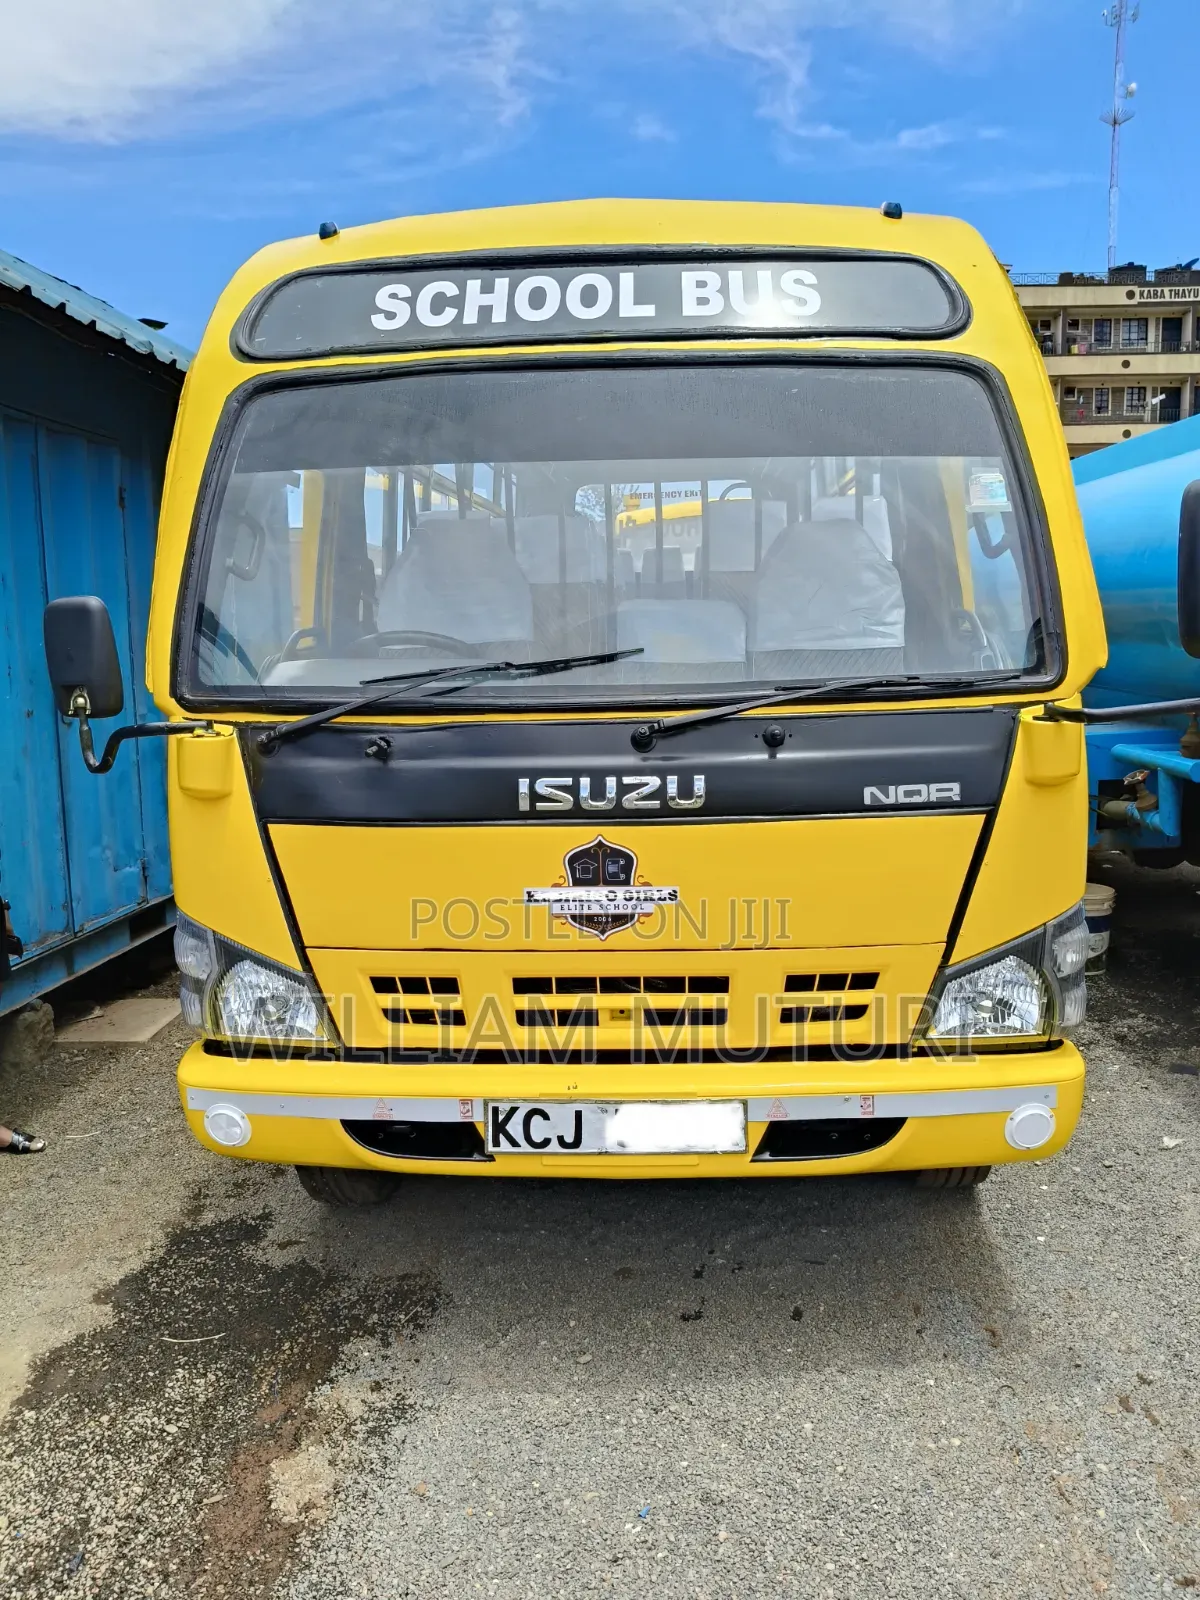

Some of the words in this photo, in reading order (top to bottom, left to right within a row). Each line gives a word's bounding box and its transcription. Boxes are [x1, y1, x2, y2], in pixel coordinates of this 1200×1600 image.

[370, 271, 656, 330] SCHOOL
[681, 269, 822, 318] BUS
[1138, 289, 1166, 300] KABA
[1168, 288, 1200, 299] THAYU
[629, 490, 682, 500] EMERENCY
[518, 775, 706, 812] ISUZU
[863, 781, 962, 805] NQR
[560, 903, 593, 911] ELITE
[598, 903, 645, 911] SCHOOL
[492, 1105, 583, 1150] KCJ
